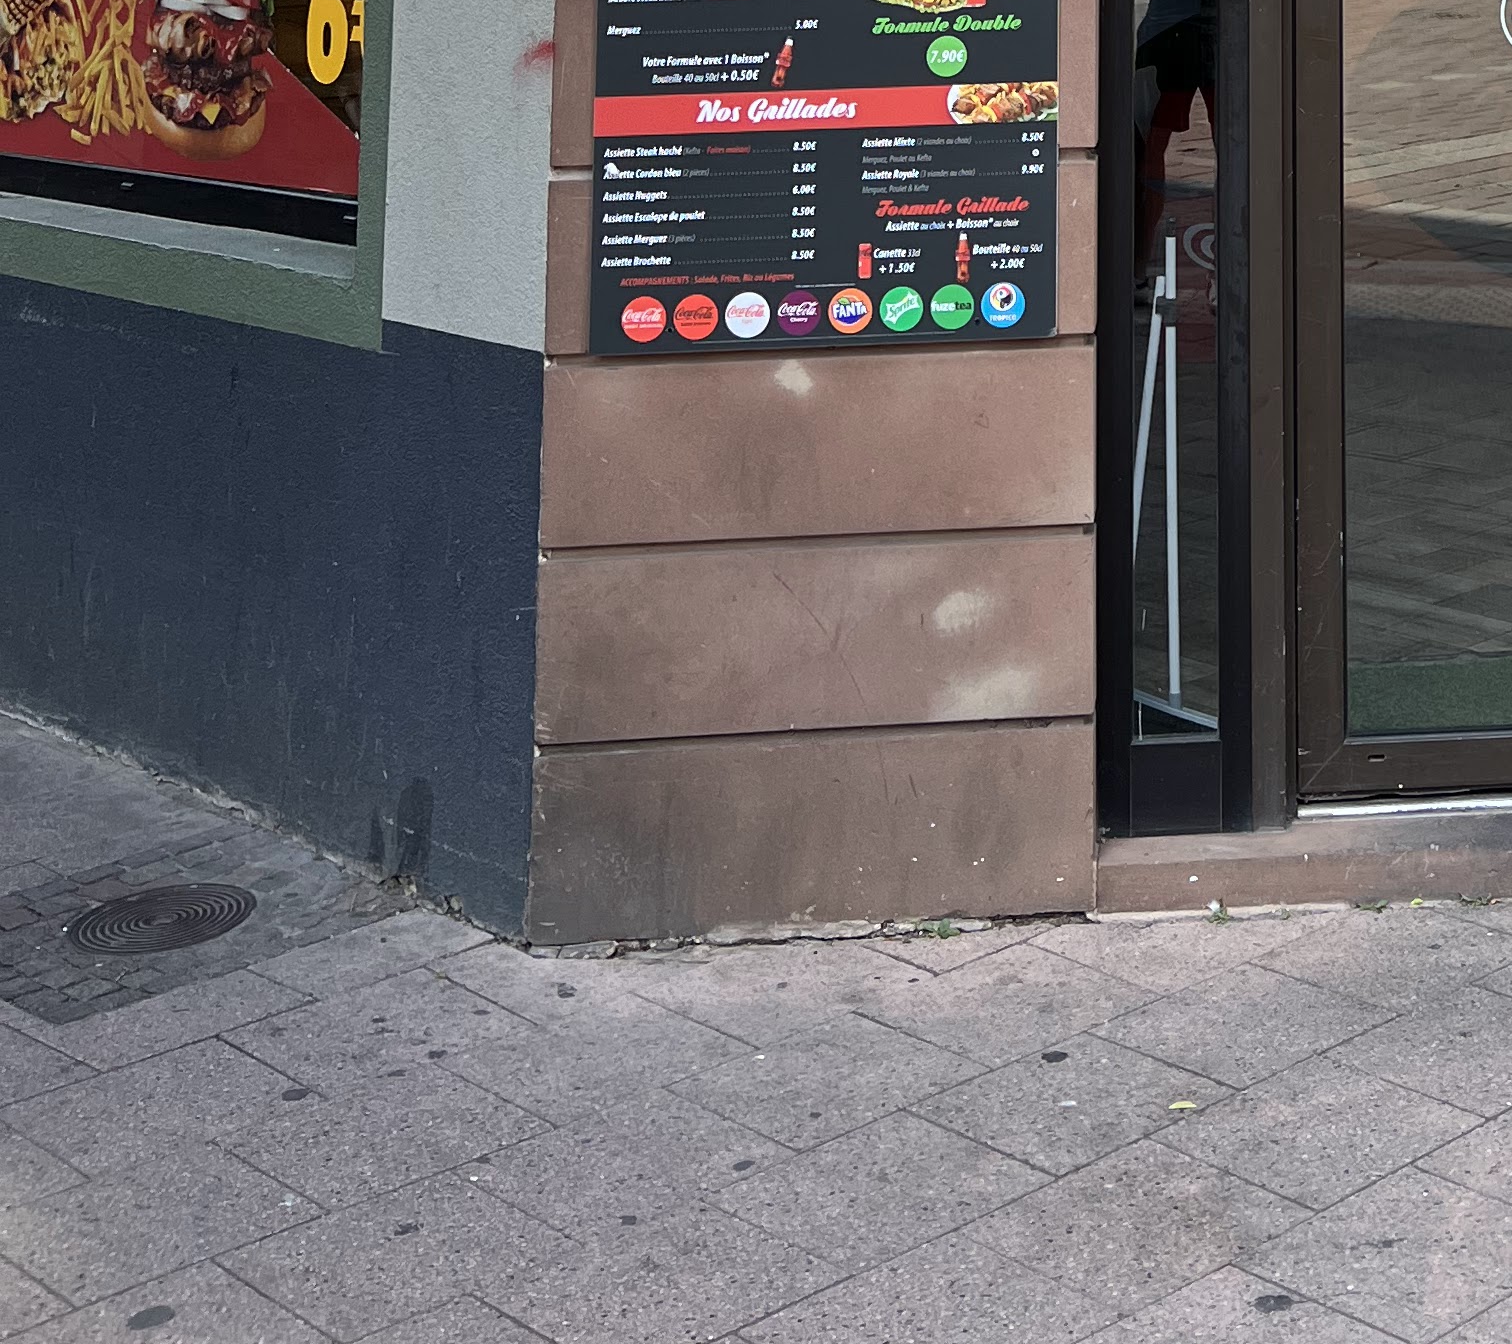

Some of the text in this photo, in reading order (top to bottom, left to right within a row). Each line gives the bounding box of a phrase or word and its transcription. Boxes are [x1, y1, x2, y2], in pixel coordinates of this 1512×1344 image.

[872, 15, 1022, 34] Formule Double
[930, 50, 964, 63] 7.90€
[696, 98, 856, 123] Nos Grillades
[862, 137, 892, 148] Assiette
[1022, 132, 1044, 142] 8.50€
[793, 142, 816, 151] 8.50€
[604, 147, 635, 158] Assiette
[862, 170, 892, 180] Assiette
[603, 192, 634, 202] Assiette
[876, 196, 1029, 217] Formule Grillade
[973, 243, 1011, 255] Bouteille
[791, 250, 814, 260] 8.50€
[601, 256, 671, 267] Assiette Brochette
